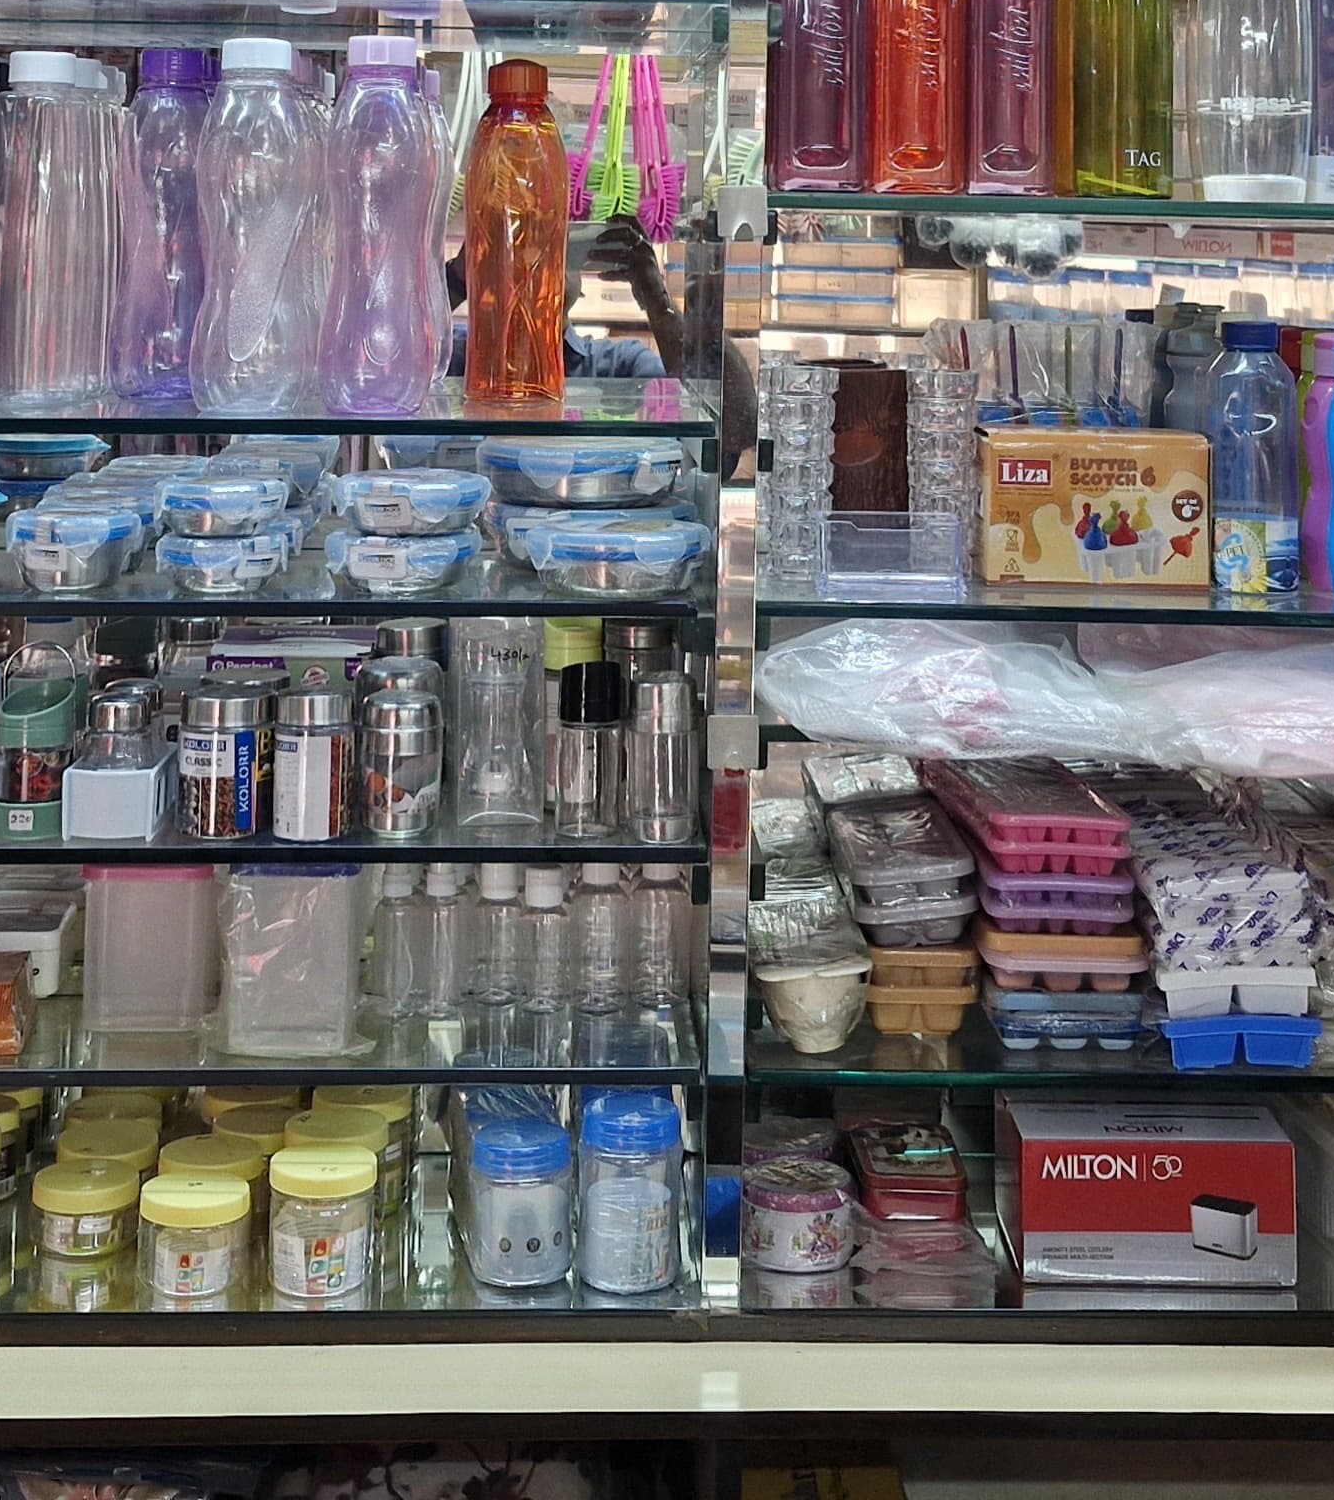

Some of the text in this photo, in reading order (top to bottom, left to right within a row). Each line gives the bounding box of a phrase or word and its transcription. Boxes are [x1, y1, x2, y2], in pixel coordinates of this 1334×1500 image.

[1124, 148, 1161, 168] TAG
[1001, 462, 1049, 483] Liza
[1069, 457, 1138, 472] BUTTER
[1069, 466, 1157, 487] SCOTCH 6
[238, 744, 249, 814] KOLORR
[1041, 1154, 1137, 1180] MILTON
